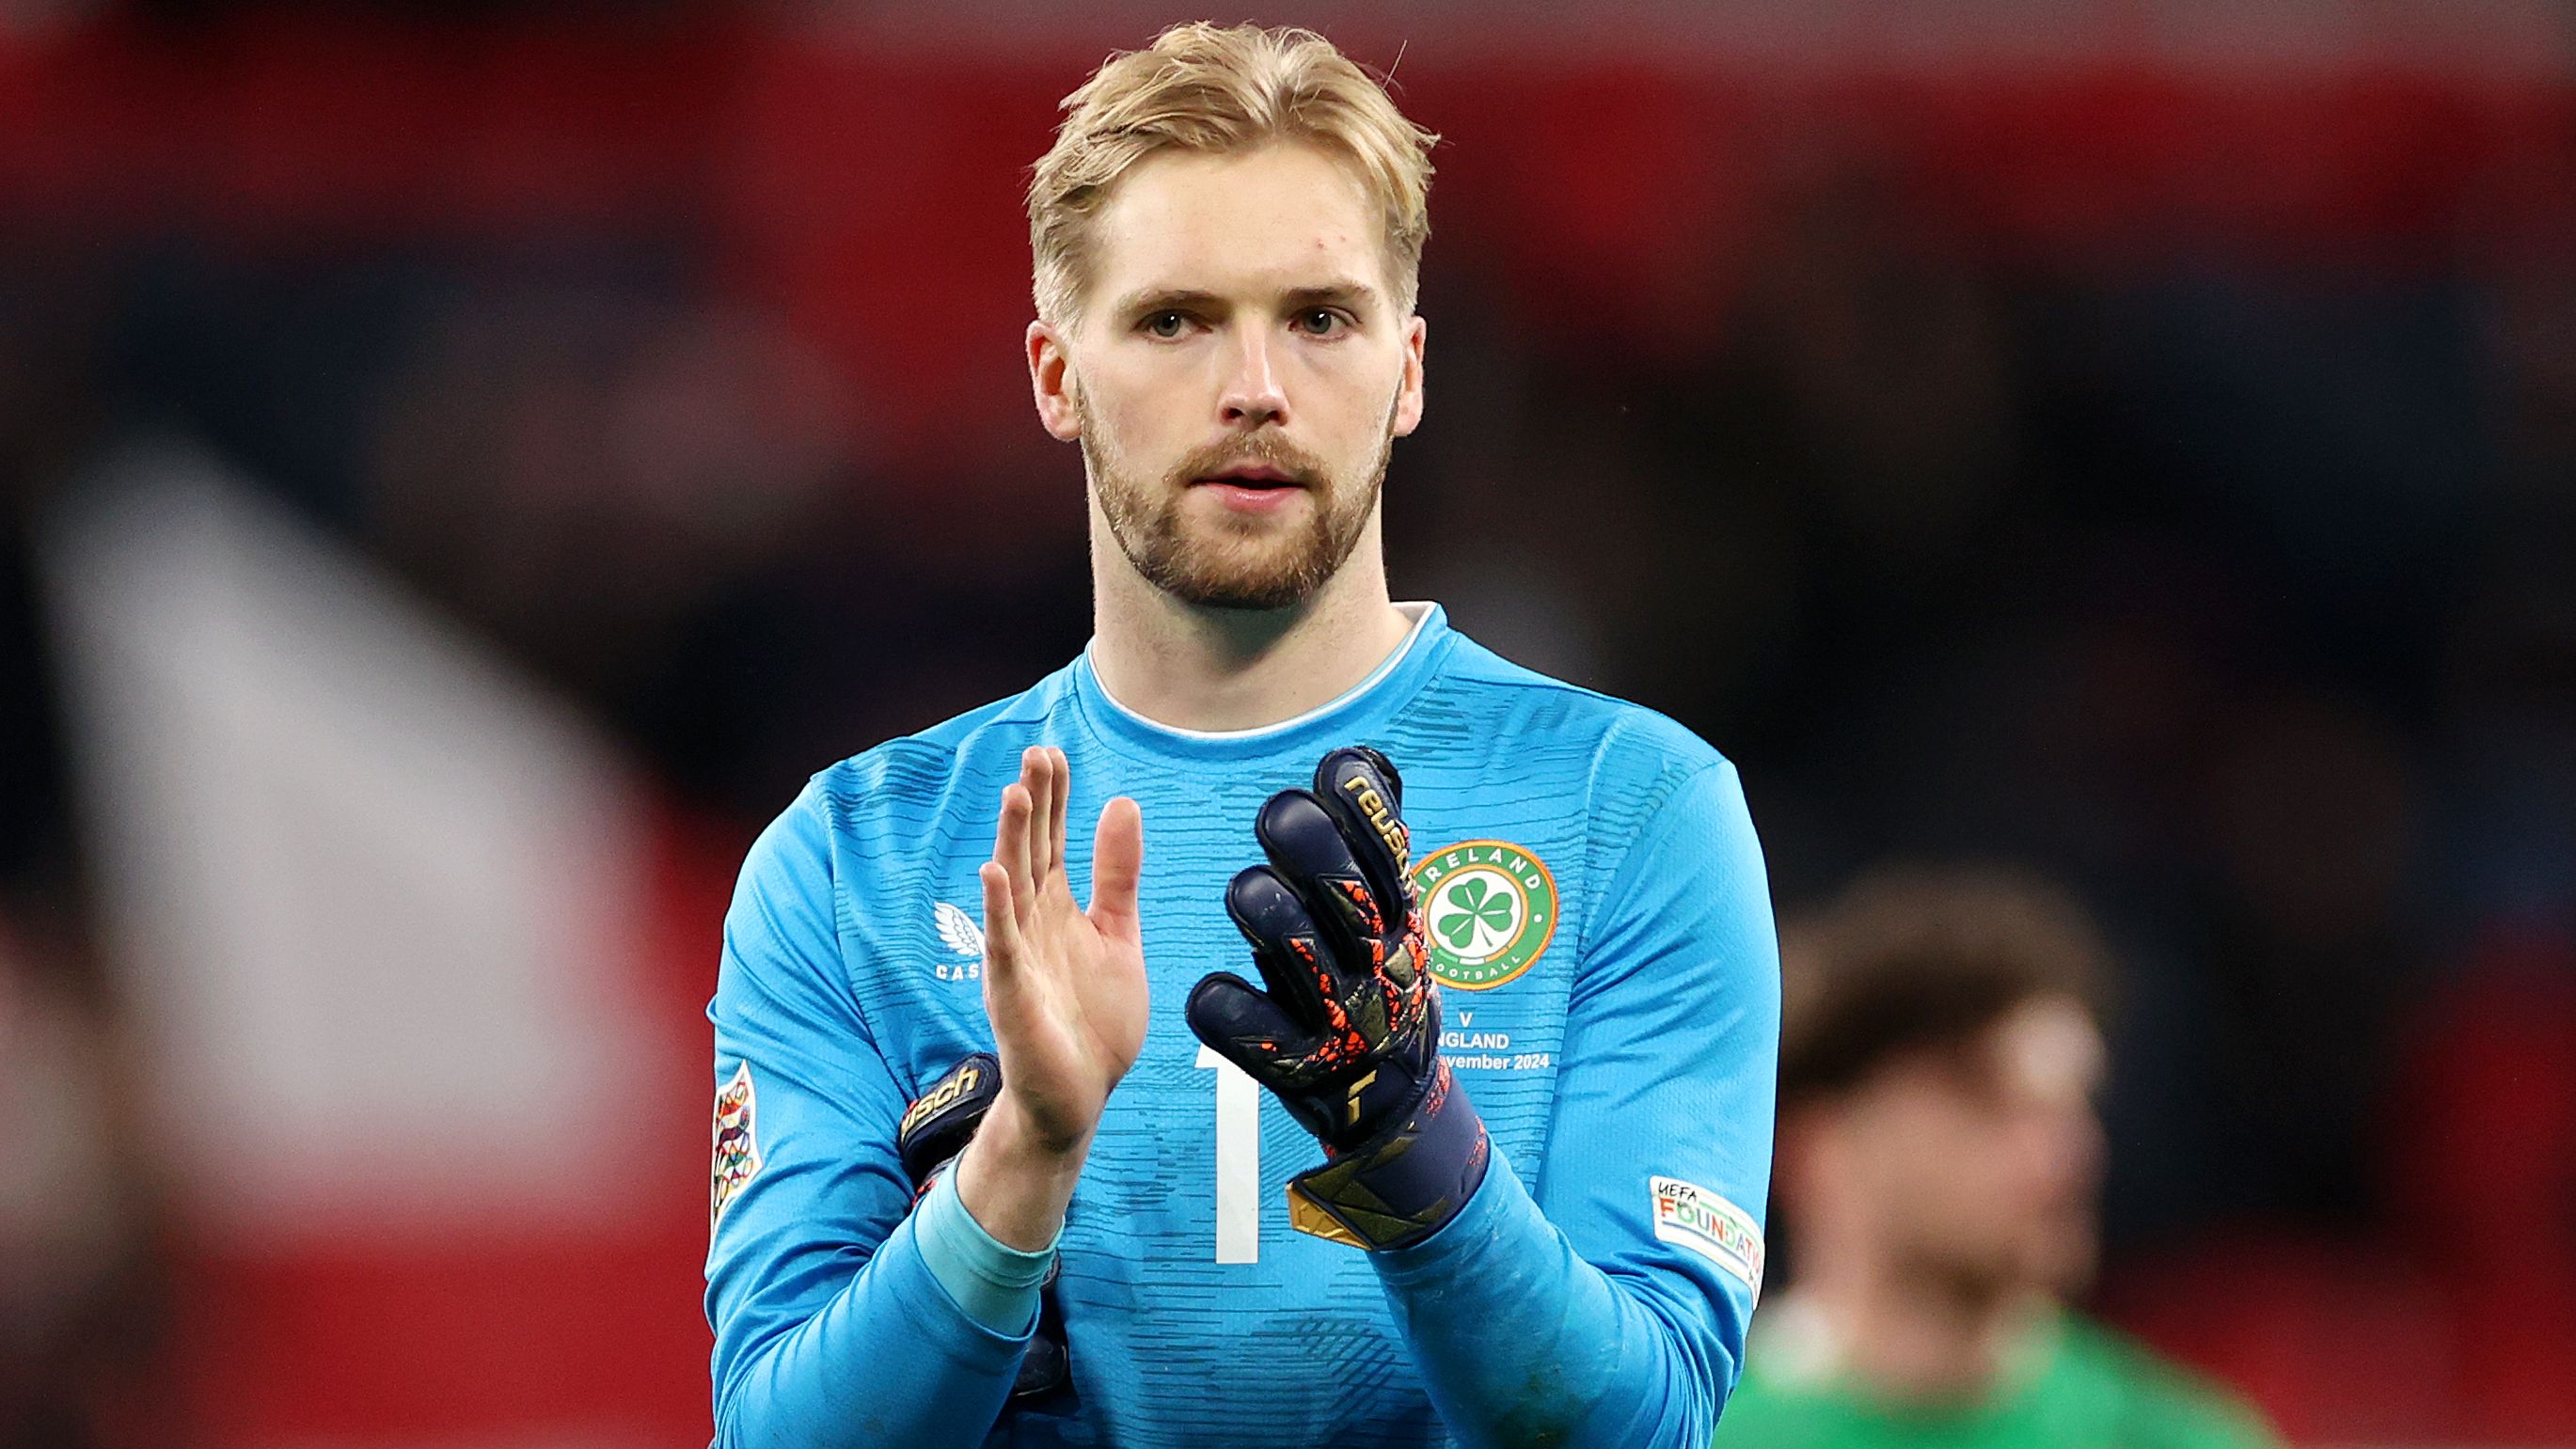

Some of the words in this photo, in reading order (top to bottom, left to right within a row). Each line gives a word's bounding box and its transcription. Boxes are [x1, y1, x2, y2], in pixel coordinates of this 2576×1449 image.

[1415, 848, 1541, 893] IRELAND
[936, 965, 979, 981] CAS
[1430, 954, 1521, 980] OOTBALL
[1460, 1012, 1473, 1028] V
[1437, 1032, 1509, 1049] NGLAND
[1446, 1054, 1510, 1069] vember
[1513, 1053, 1550, 1070] 2024
[901, 1066, 979, 1142] usch
[1194, 1043, 1260, 1264] 1
[1658, 1182, 1698, 1203] UEFA
